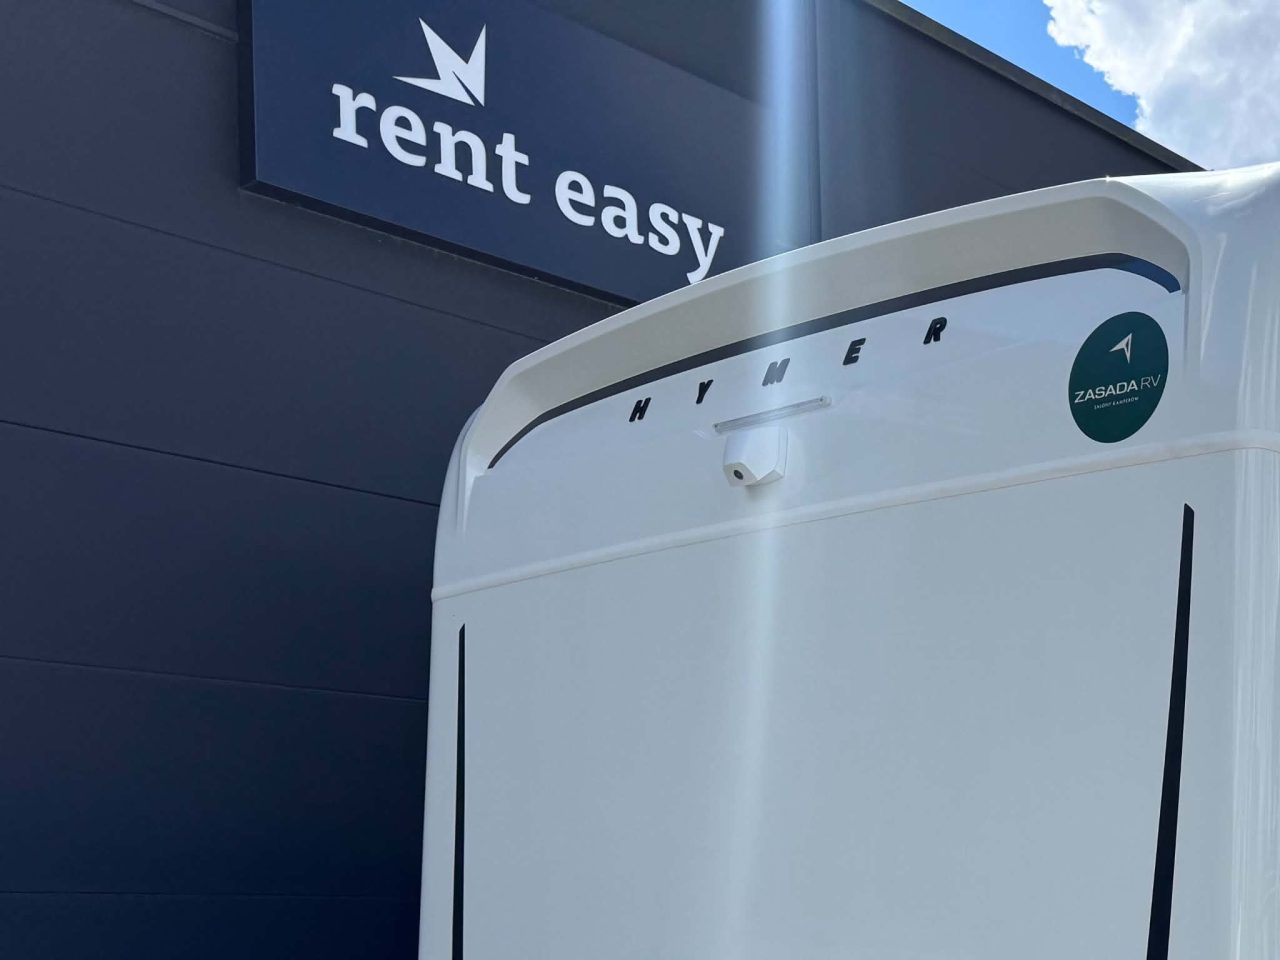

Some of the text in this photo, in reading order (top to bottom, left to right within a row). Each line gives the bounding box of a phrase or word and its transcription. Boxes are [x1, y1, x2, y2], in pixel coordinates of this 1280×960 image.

[331, 82, 725, 285] rent easy
[628, 315, 949, 423] HYMER
[1074, 373, 1161, 404] ZASADA RV
